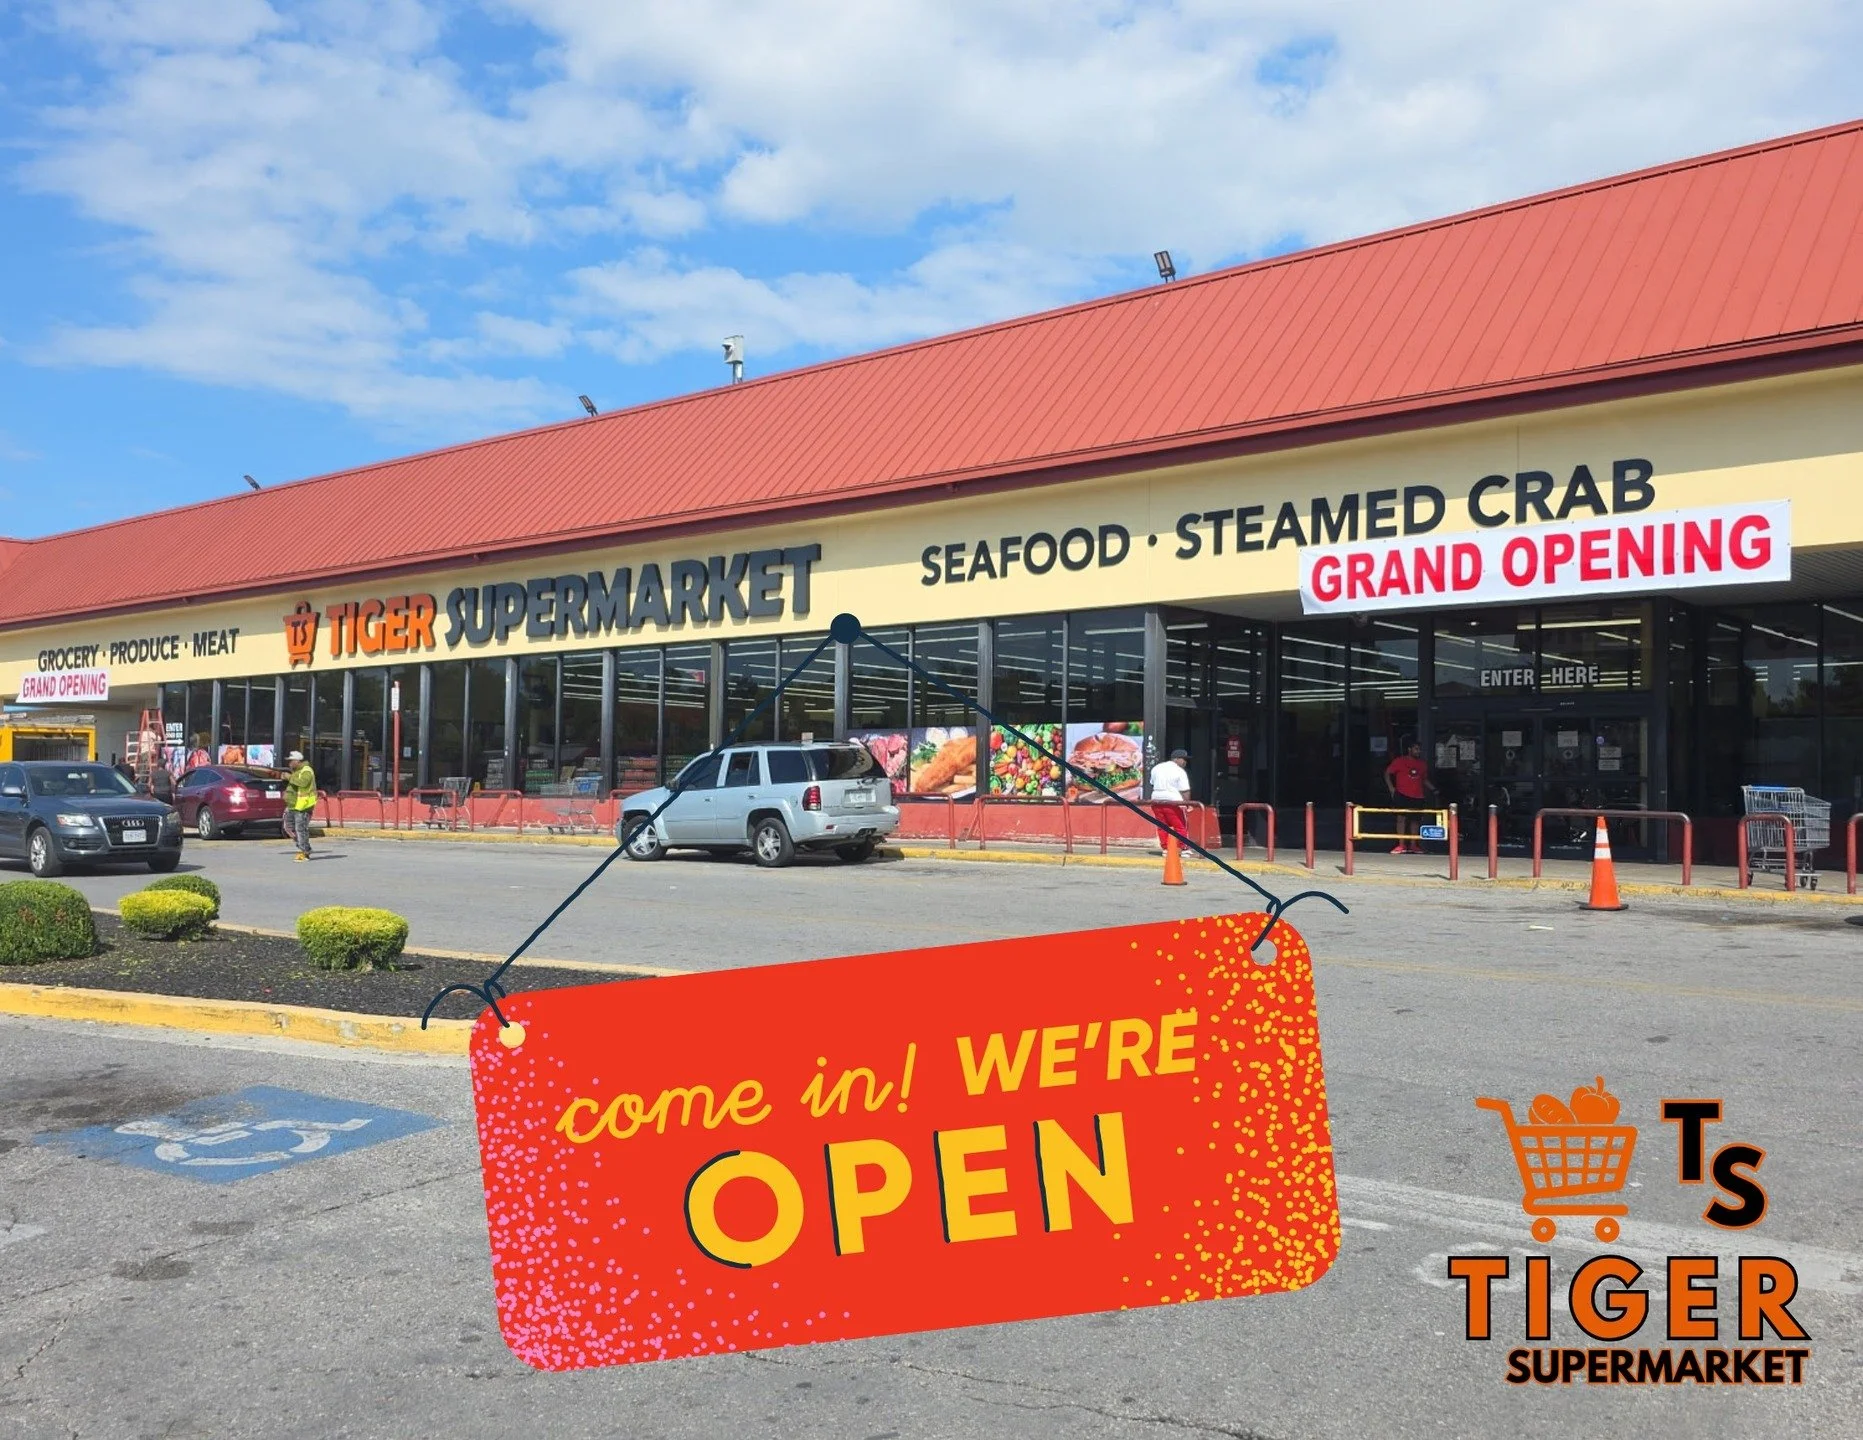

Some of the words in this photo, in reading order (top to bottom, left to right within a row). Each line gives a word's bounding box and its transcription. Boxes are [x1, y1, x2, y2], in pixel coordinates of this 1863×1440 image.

[921, 523, 1131, 587] SEAFOOD
[1175, 484, 1446, 560] STEAMED
[1467, 458, 1656, 528] CRAB
[1311, 541, 1483, 602] GRAND
[1501, 514, 1772, 587] OPENING
[325, 593, 438, 657] TIGER
[444, 543, 822, 647] SUPERMARKET
[37, 643, 100, 673] GROCERY
[109, 634, 180, 666] PRODUCE
[192, 628, 240, 658] MEAT
[1480, 668, 1535, 688] ENTER
[1551, 665, 1599, 685] HERE
[23, 675, 57, 698] GRAND
[59, 673, 106, 696] OPENING
